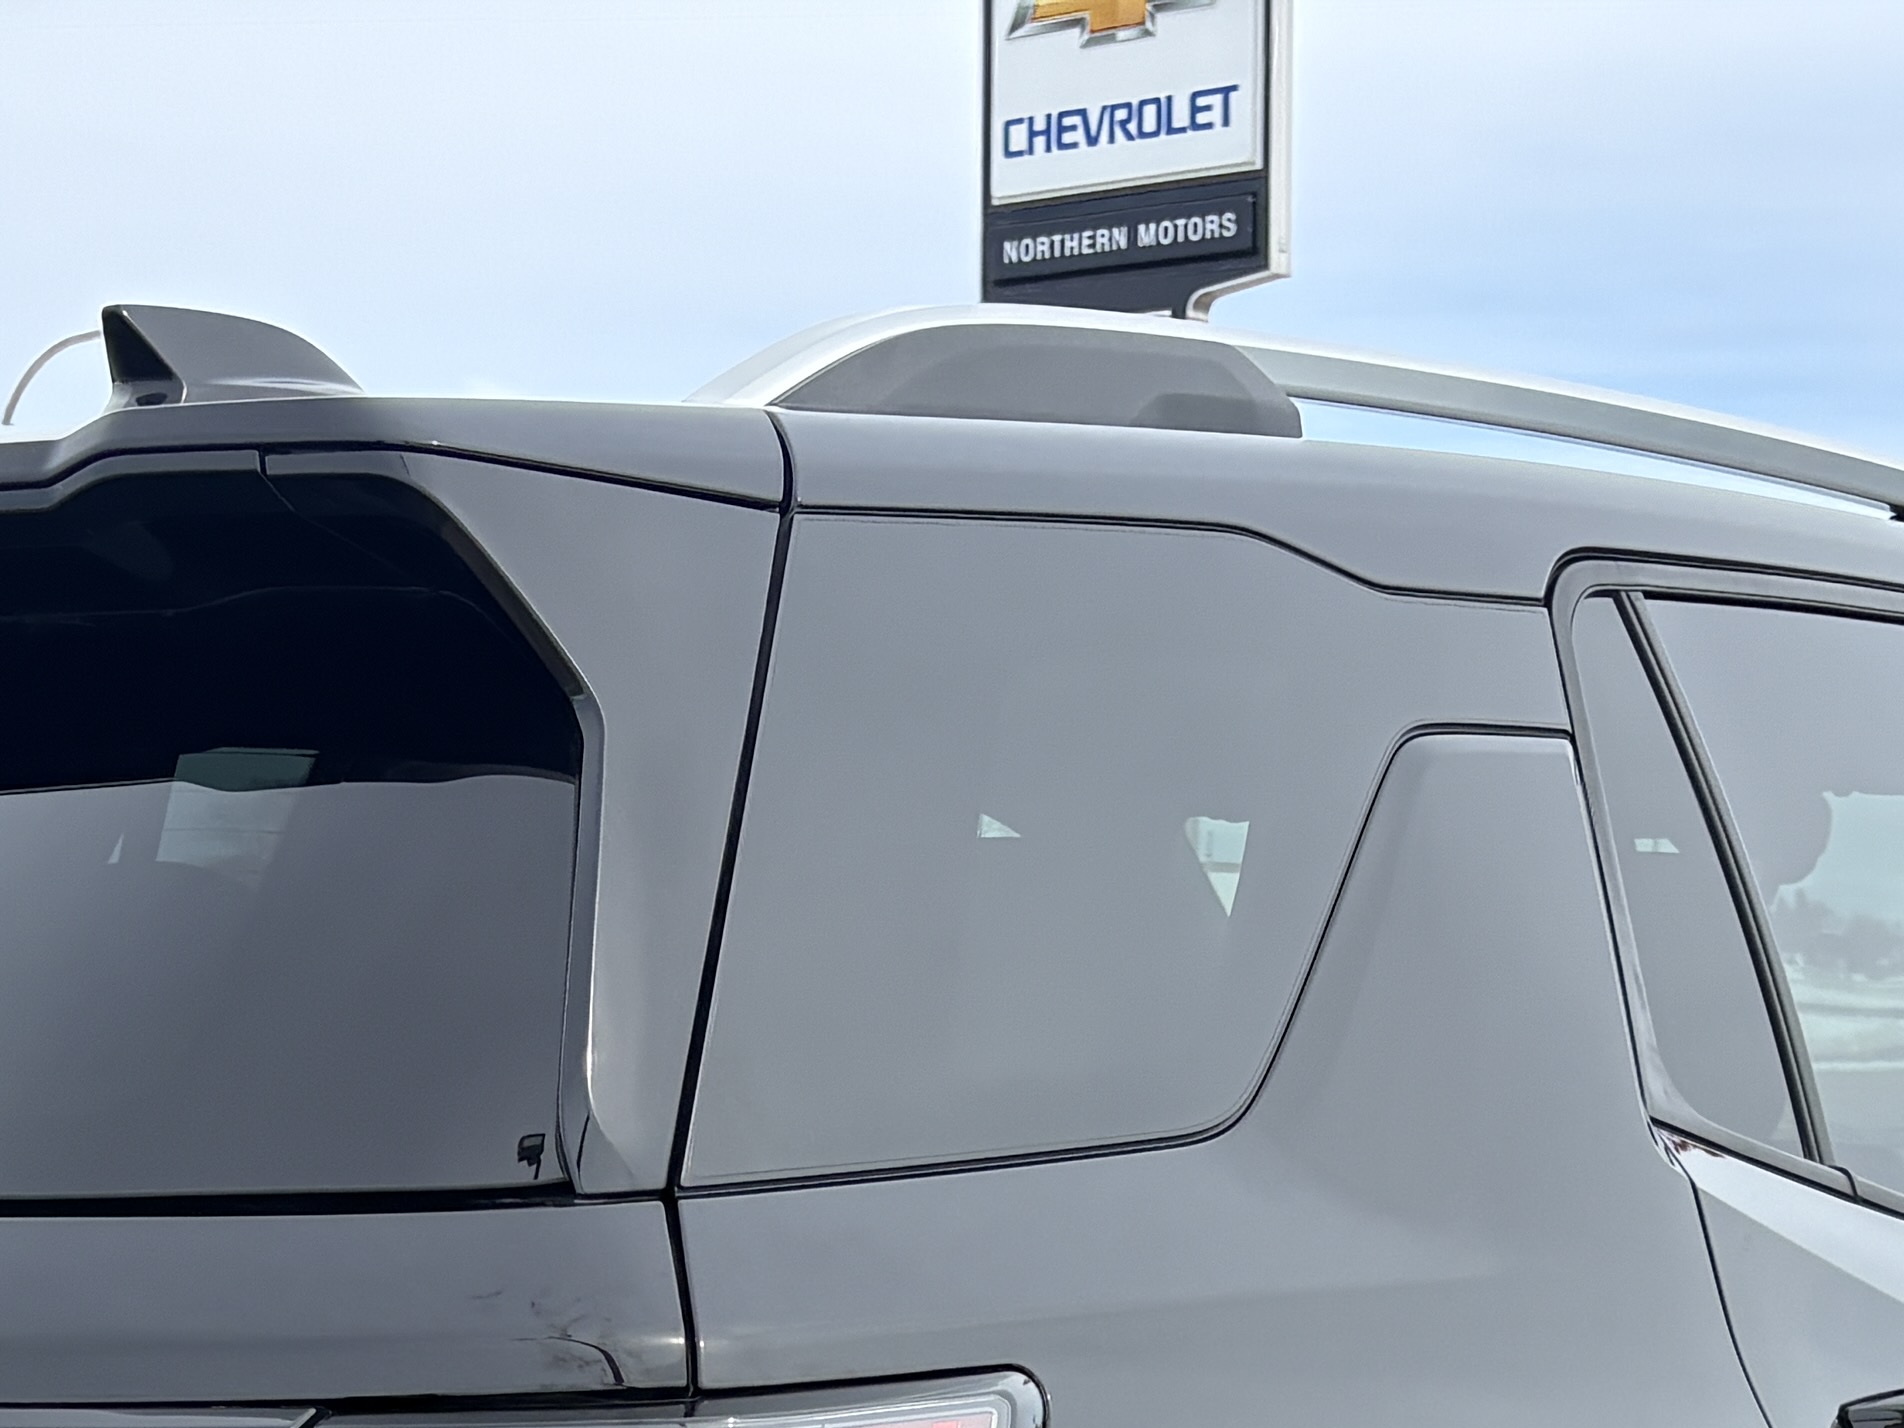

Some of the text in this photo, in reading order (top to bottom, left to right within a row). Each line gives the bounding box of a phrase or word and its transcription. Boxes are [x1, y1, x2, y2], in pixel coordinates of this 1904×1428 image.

[1003, 84, 1239, 159] CHEVROLET
[1003, 212, 1238, 264] NORTHERN MOTORS
